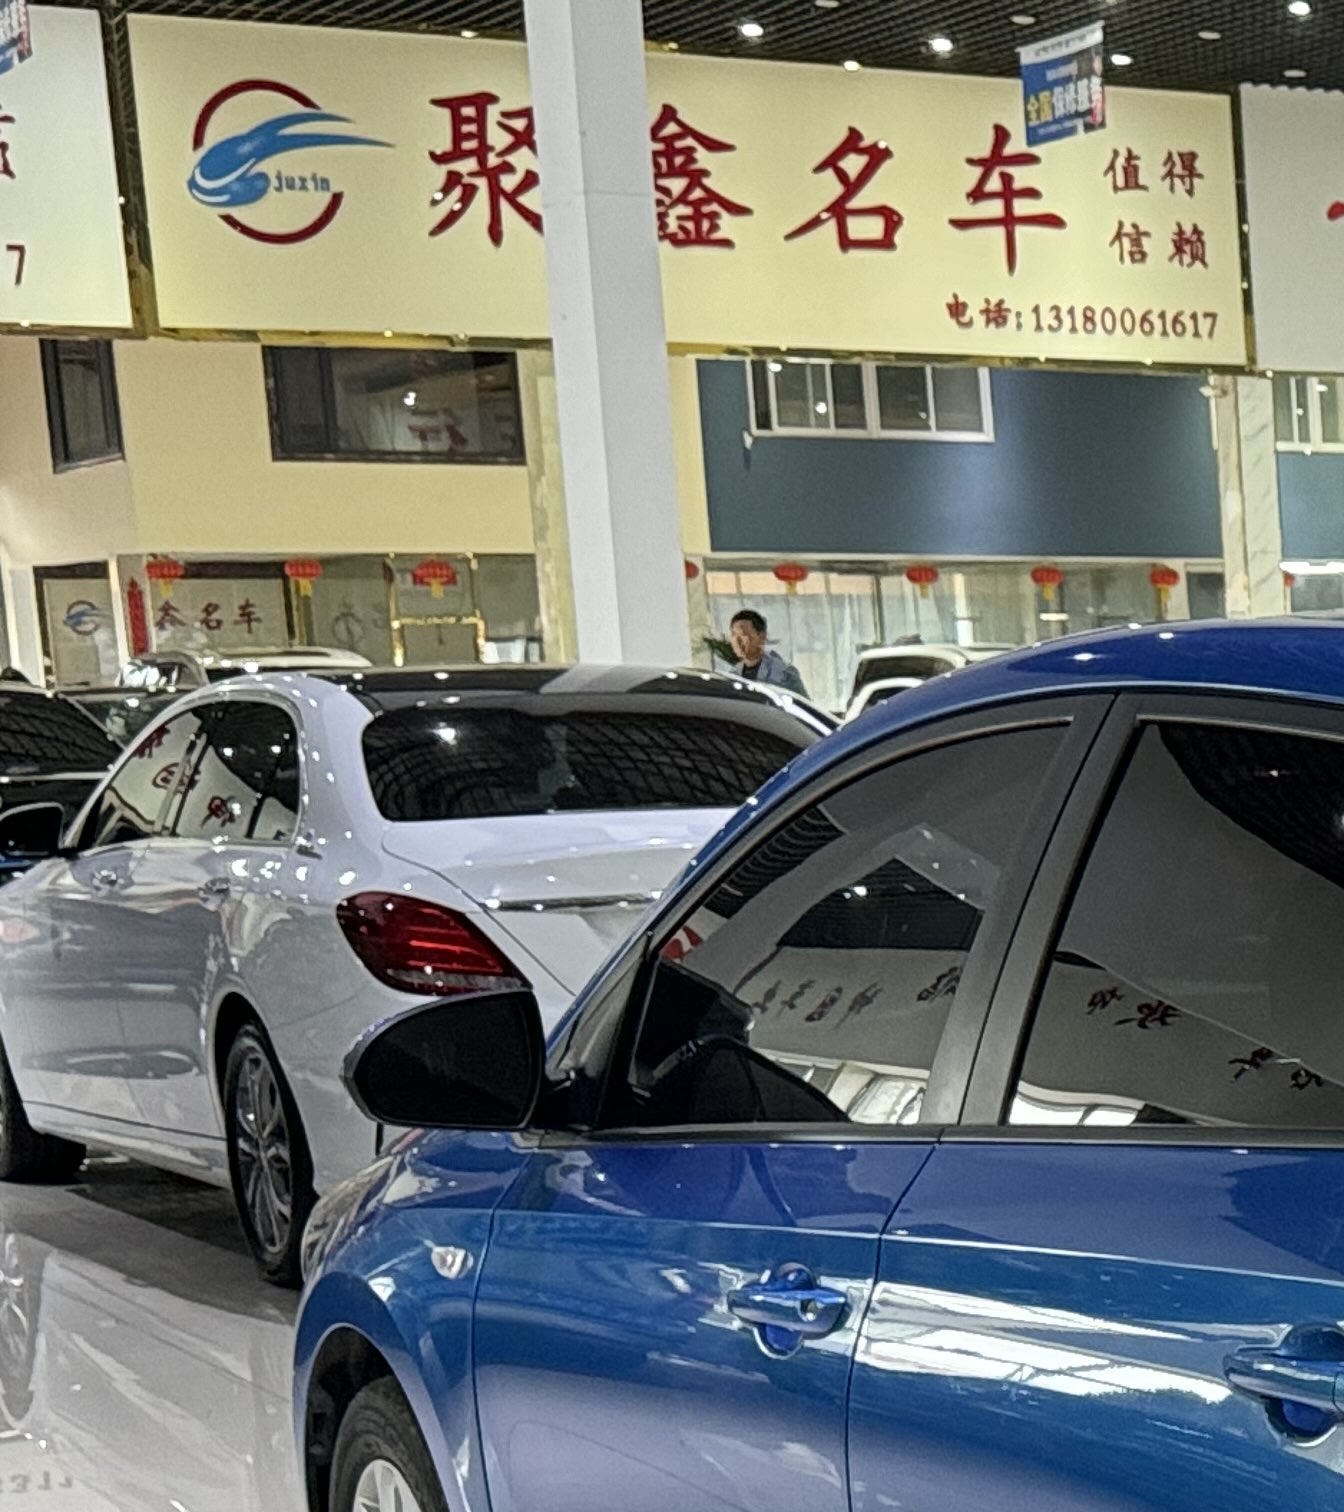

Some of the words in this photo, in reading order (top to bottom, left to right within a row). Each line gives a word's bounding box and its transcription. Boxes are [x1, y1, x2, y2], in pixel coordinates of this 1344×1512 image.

[274, 170, 331, 193] juxin
[1103, 146, 1205, 198] 值得
[1108, 219, 1209, 270] 信赖
